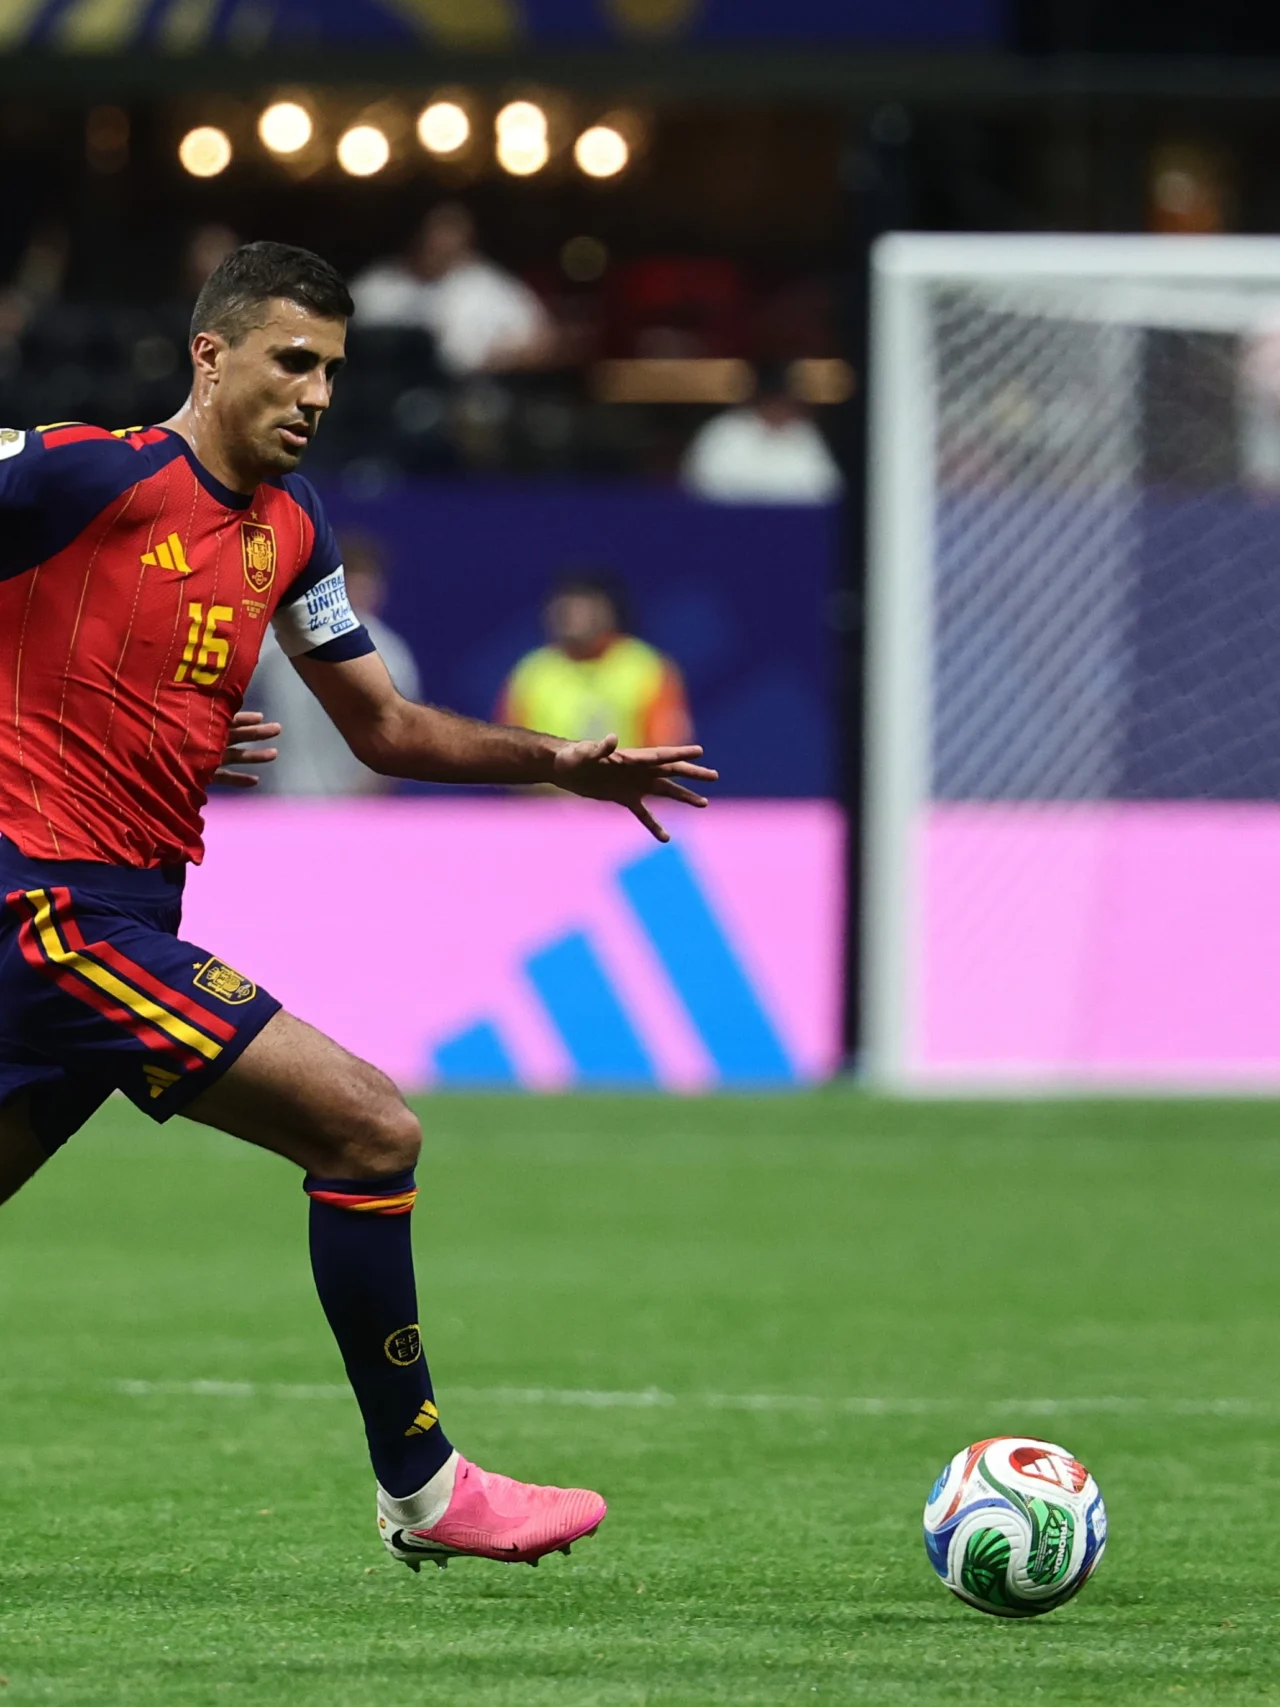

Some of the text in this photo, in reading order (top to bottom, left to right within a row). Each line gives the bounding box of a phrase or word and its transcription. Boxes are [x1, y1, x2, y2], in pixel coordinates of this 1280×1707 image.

[304, 575, 345, 600] FOOTBAL
[307, 586, 346, 616] UNITE
[307, 615, 330, 632] the
[173, 602, 233, 685] 16
[1053, 1517, 1068, 1575] TRIONDA
